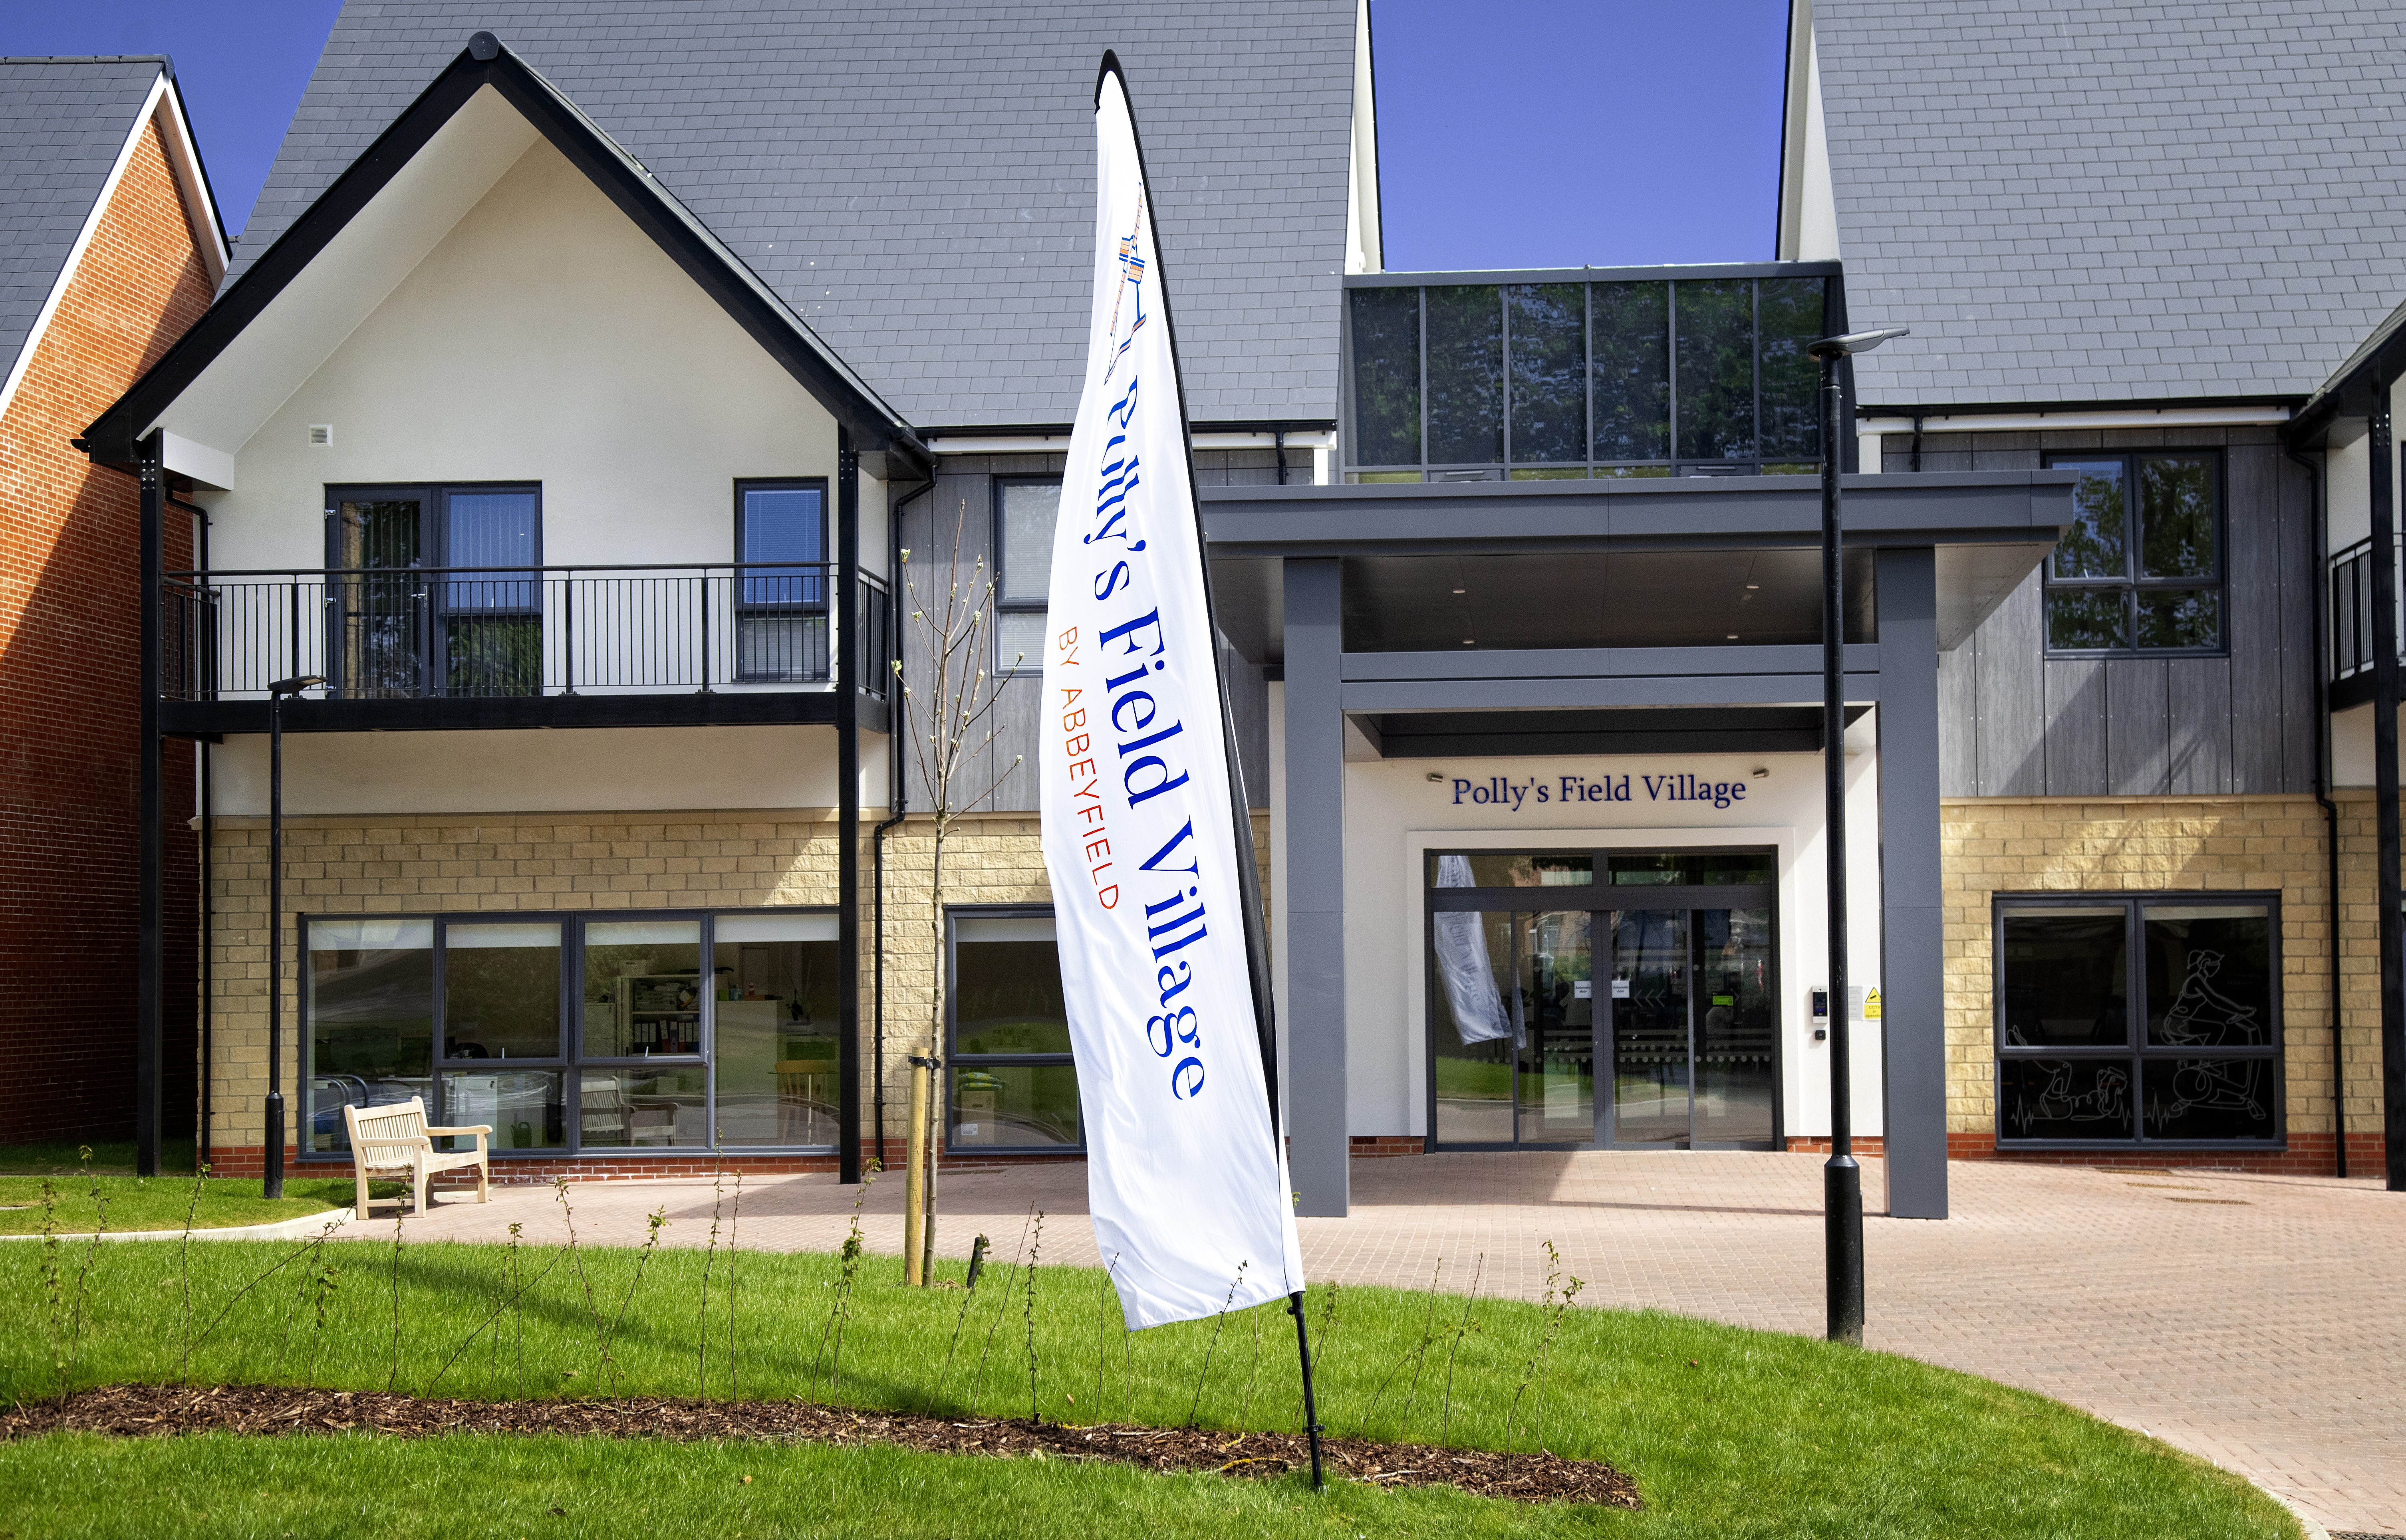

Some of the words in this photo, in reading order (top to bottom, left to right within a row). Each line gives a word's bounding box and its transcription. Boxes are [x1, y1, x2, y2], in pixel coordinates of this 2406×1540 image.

[1083, 375, 1146, 601] Polly's
[1058, 626, 1079, 666] BY
[1098, 606, 1190, 811] Field
[1060, 688, 1119, 910] ABBEYFIELD
[1452, 777, 1549, 812] Polly's
[1559, 777, 1632, 802] Field
[1642, 774, 1746, 809] Village
[1138, 814, 1208, 1100] Village
